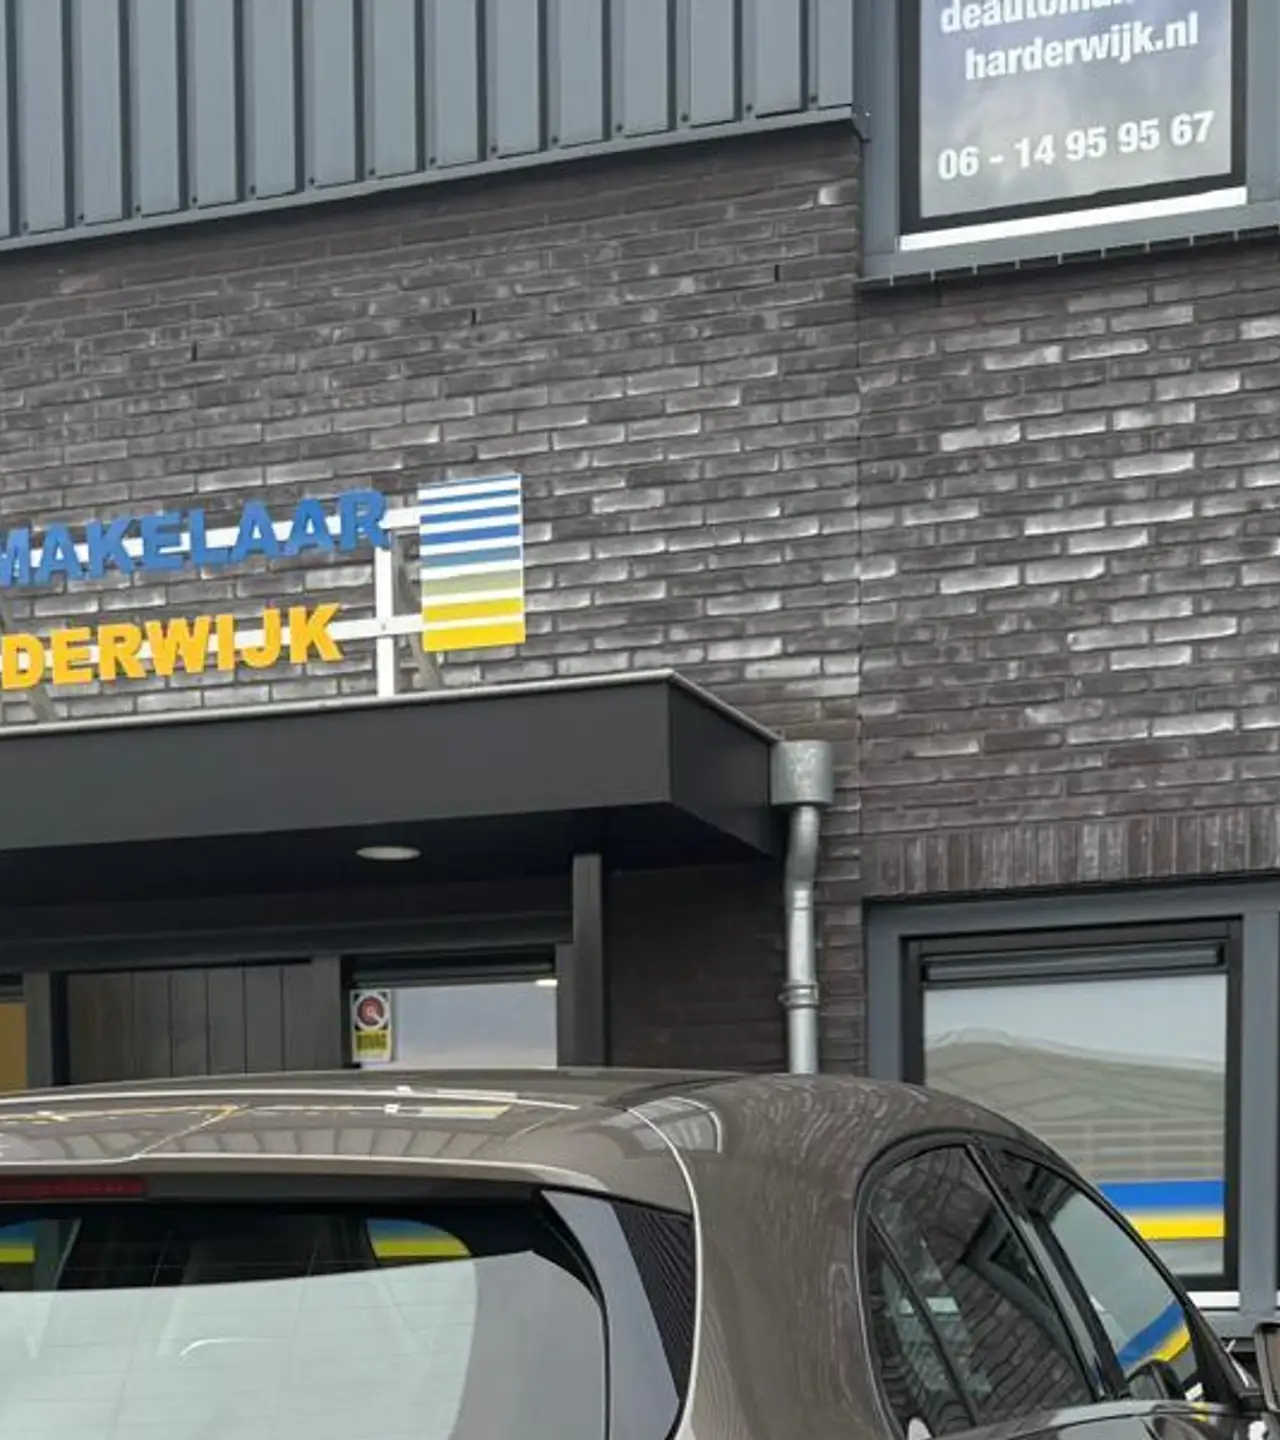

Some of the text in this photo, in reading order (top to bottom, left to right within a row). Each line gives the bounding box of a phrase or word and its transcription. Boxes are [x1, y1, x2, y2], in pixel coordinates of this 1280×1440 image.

[965, 11, 1198, 80] harderwijk.nl
[937, 145, 980, 181] 06
[1014, 133, 1056, 169] 14
[1065, 126, 1107, 162] 95
[1118, 117, 1160, 153] 95
[1171, 109, 1214, 146] 67
